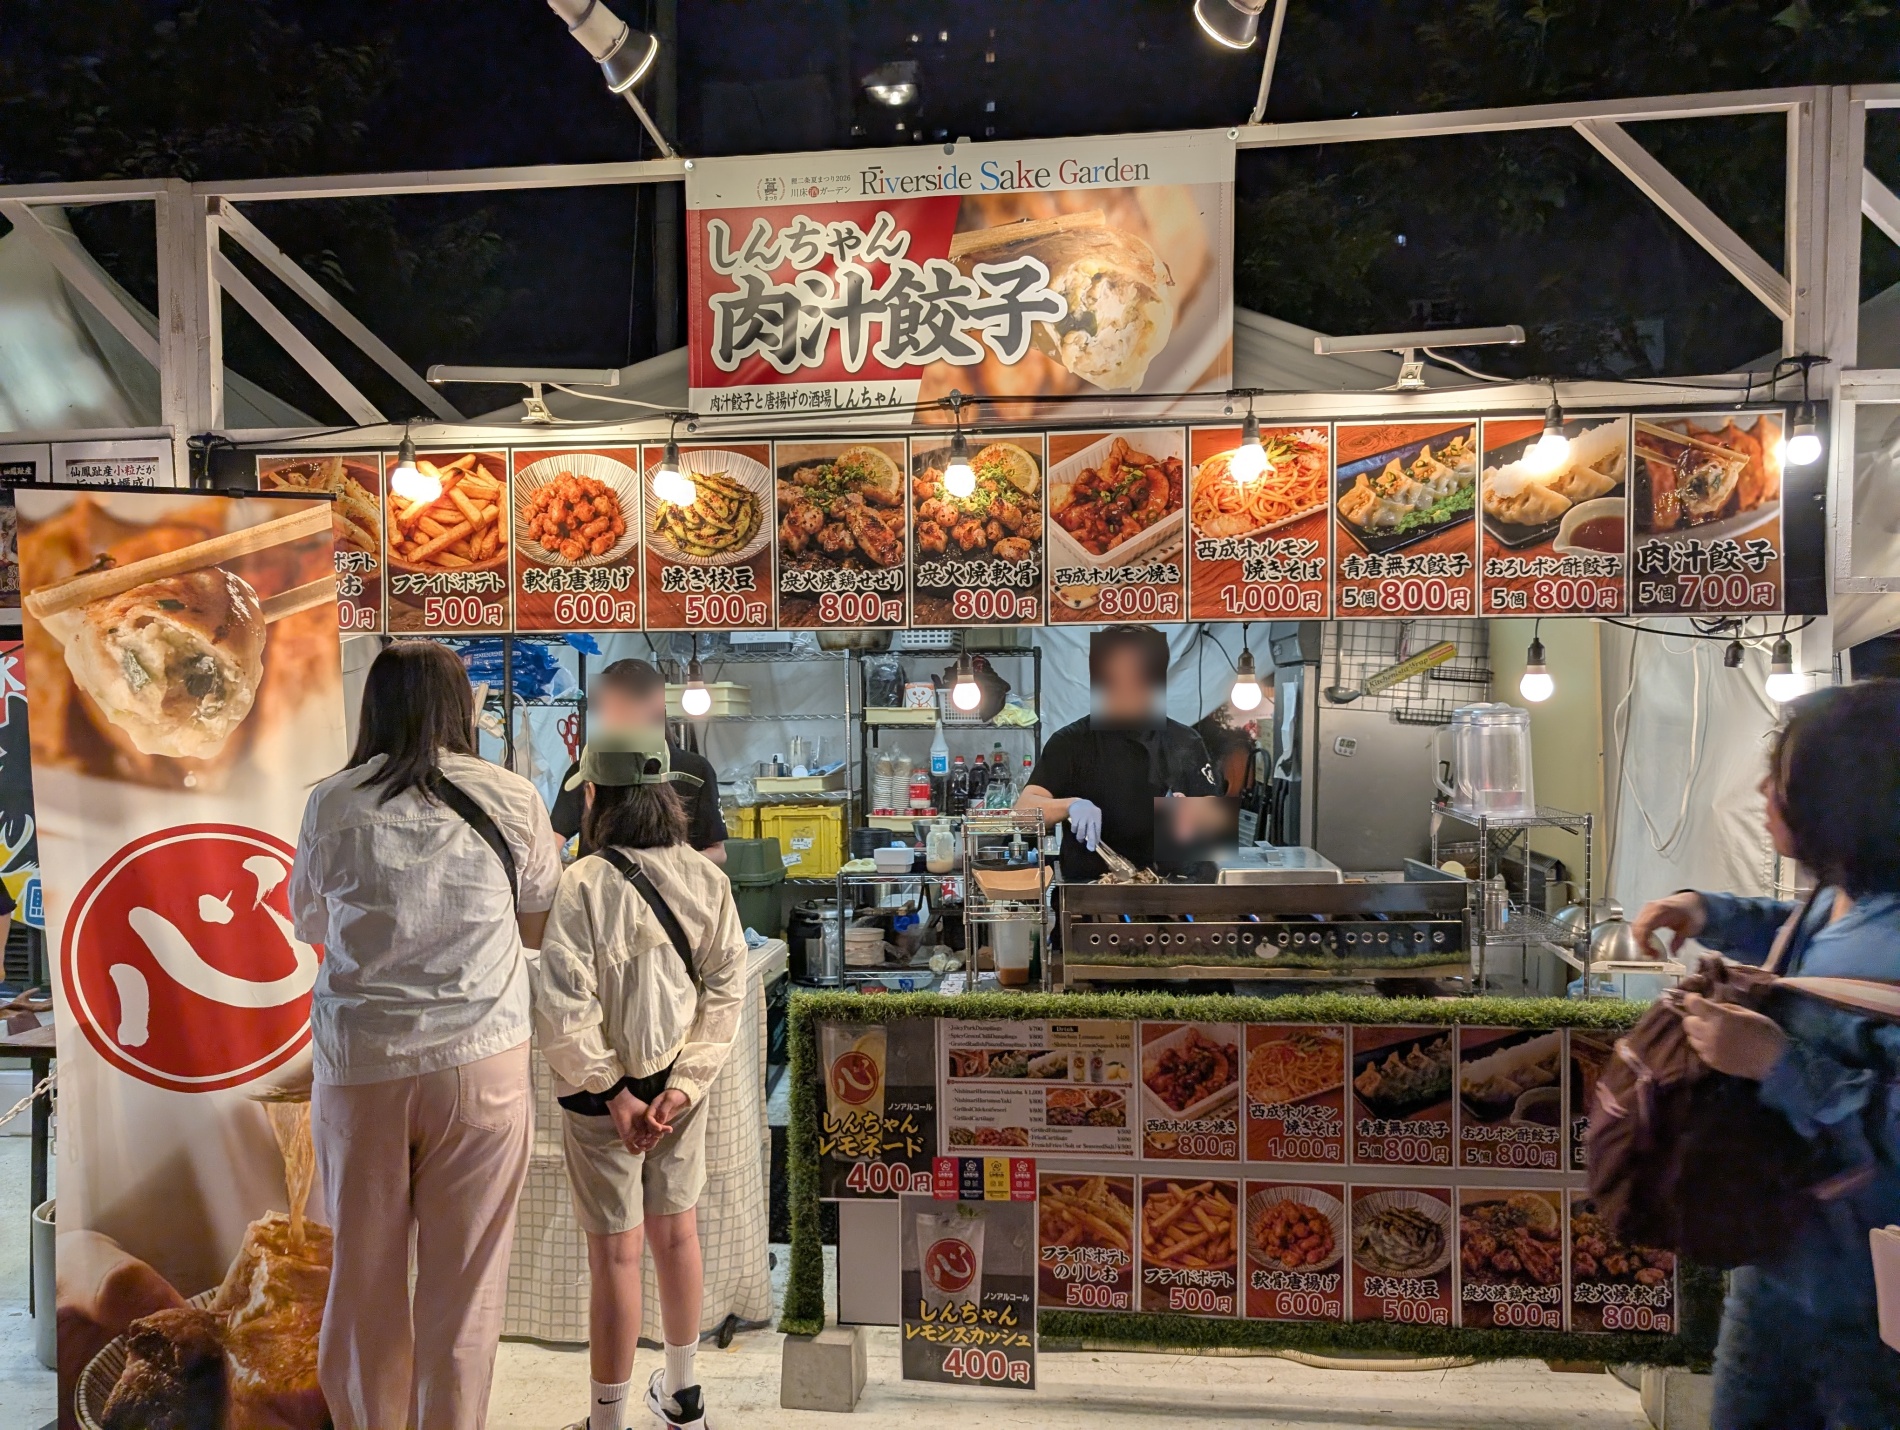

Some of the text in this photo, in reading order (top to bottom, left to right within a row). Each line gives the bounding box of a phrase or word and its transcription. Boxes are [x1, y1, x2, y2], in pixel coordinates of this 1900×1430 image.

[980, 160, 1051, 190] Sake
[1058, 157, 1150, 184] Garden
[711, 213, 907, 271] しんちゃん
[714, 259, 1064, 370] 肉汁餃子
[710, 386, 902, 411] 肉汁餃子と唐揚げの酒場しんちゃん
[70, 464, 156, 477] 仙鳳趾産小粒だが
[1196, 538, 1318, 560] 西成ホルモン
[1637, 538, 1777, 575] 肉汁餃子
[917, 560, 1038, 587] 炭火焼軟骨
[1056, 564, 1180, 585] 西成ホルモン焼き
[1242, 559, 1323, 582] 焼きそば
[1342, 553, 1471, 578] 青唐無双餃子
[1485, 555, 1622, 578] おろしポン酢餃子
[393, 572, 505, 594] フライドポテト
[524, 566, 632, 593] 軟骨唐揚げ
[662, 566, 756, 593] 焼き枝豆
[781, 569, 903, 592] 炭火焼鶏せせり
[1639, 574, 1775, 607] 5個 700円
[953, 588, 1037, 619] 800円
[1100, 587, 1178, 615] 800円
[1221, 584, 1321, 613] 1,000円
[1491, 580, 1618, 610] 5個 800円
[425, 597, 503, 625] 500円
[555, 594, 636, 624] 600円
[686, 595, 767, 624] 500円
[819, 593, 902, 622] 800円
[887, 1103, 933, 1111] ノンアルコール
[1250, 1104, 1338, 1120] 西成ホルモン
[822, 1112, 919, 1134] しんちゃん
[1146, 1119, 1237, 1135] 西成ホルモン焼き
[1284, 1119, 1342, 1137] 焼きそば
[1357, 1118, 1449, 1139] 青唐無双餃子
[1461, 1126, 1560, 1144] おろしポン酢餃子
[818, 1136, 924, 1159] レモネード
[1179, 1135, 1235, 1156] 800円
[1268, 1137, 1340, 1159] 1,000円
[1496, 1143, 1557, 1166] 800円
[846, 1162, 932, 1193] 400円
[1042, 1246, 1130, 1265] フライドポテト
[1054, 1263, 1118, 1283] のりしお
[1145, 1268, 1234, 1287] フライドポテト
[1252, 1270, 1340, 1292] 軟骨唐揚げ
[983, 1292, 1029, 1301] ノンアルコール
[1066, 1283, 1128, 1309] 500円
[1169, 1287, 1232, 1312] 500円
[1365, 1277, 1440, 1299] 焼き枝豆
[1463, 1283, 1561, 1304] 炭火焼鶏せせり
[1575, 1283, 1672, 1307] 炭火焼軟骨
[920, 1300, 1017, 1326] しんちゃん
[1276, 1292, 1340, 1317] 600円
[1383, 1300, 1448, 1325] 500円
[1493, 1303, 1560, 1328] 800円
[1602, 1305, 1670, 1331] 800円
[905, 1323, 1031, 1347] レモンスカッシュ
[943, 1348, 1030, 1384] 400円
